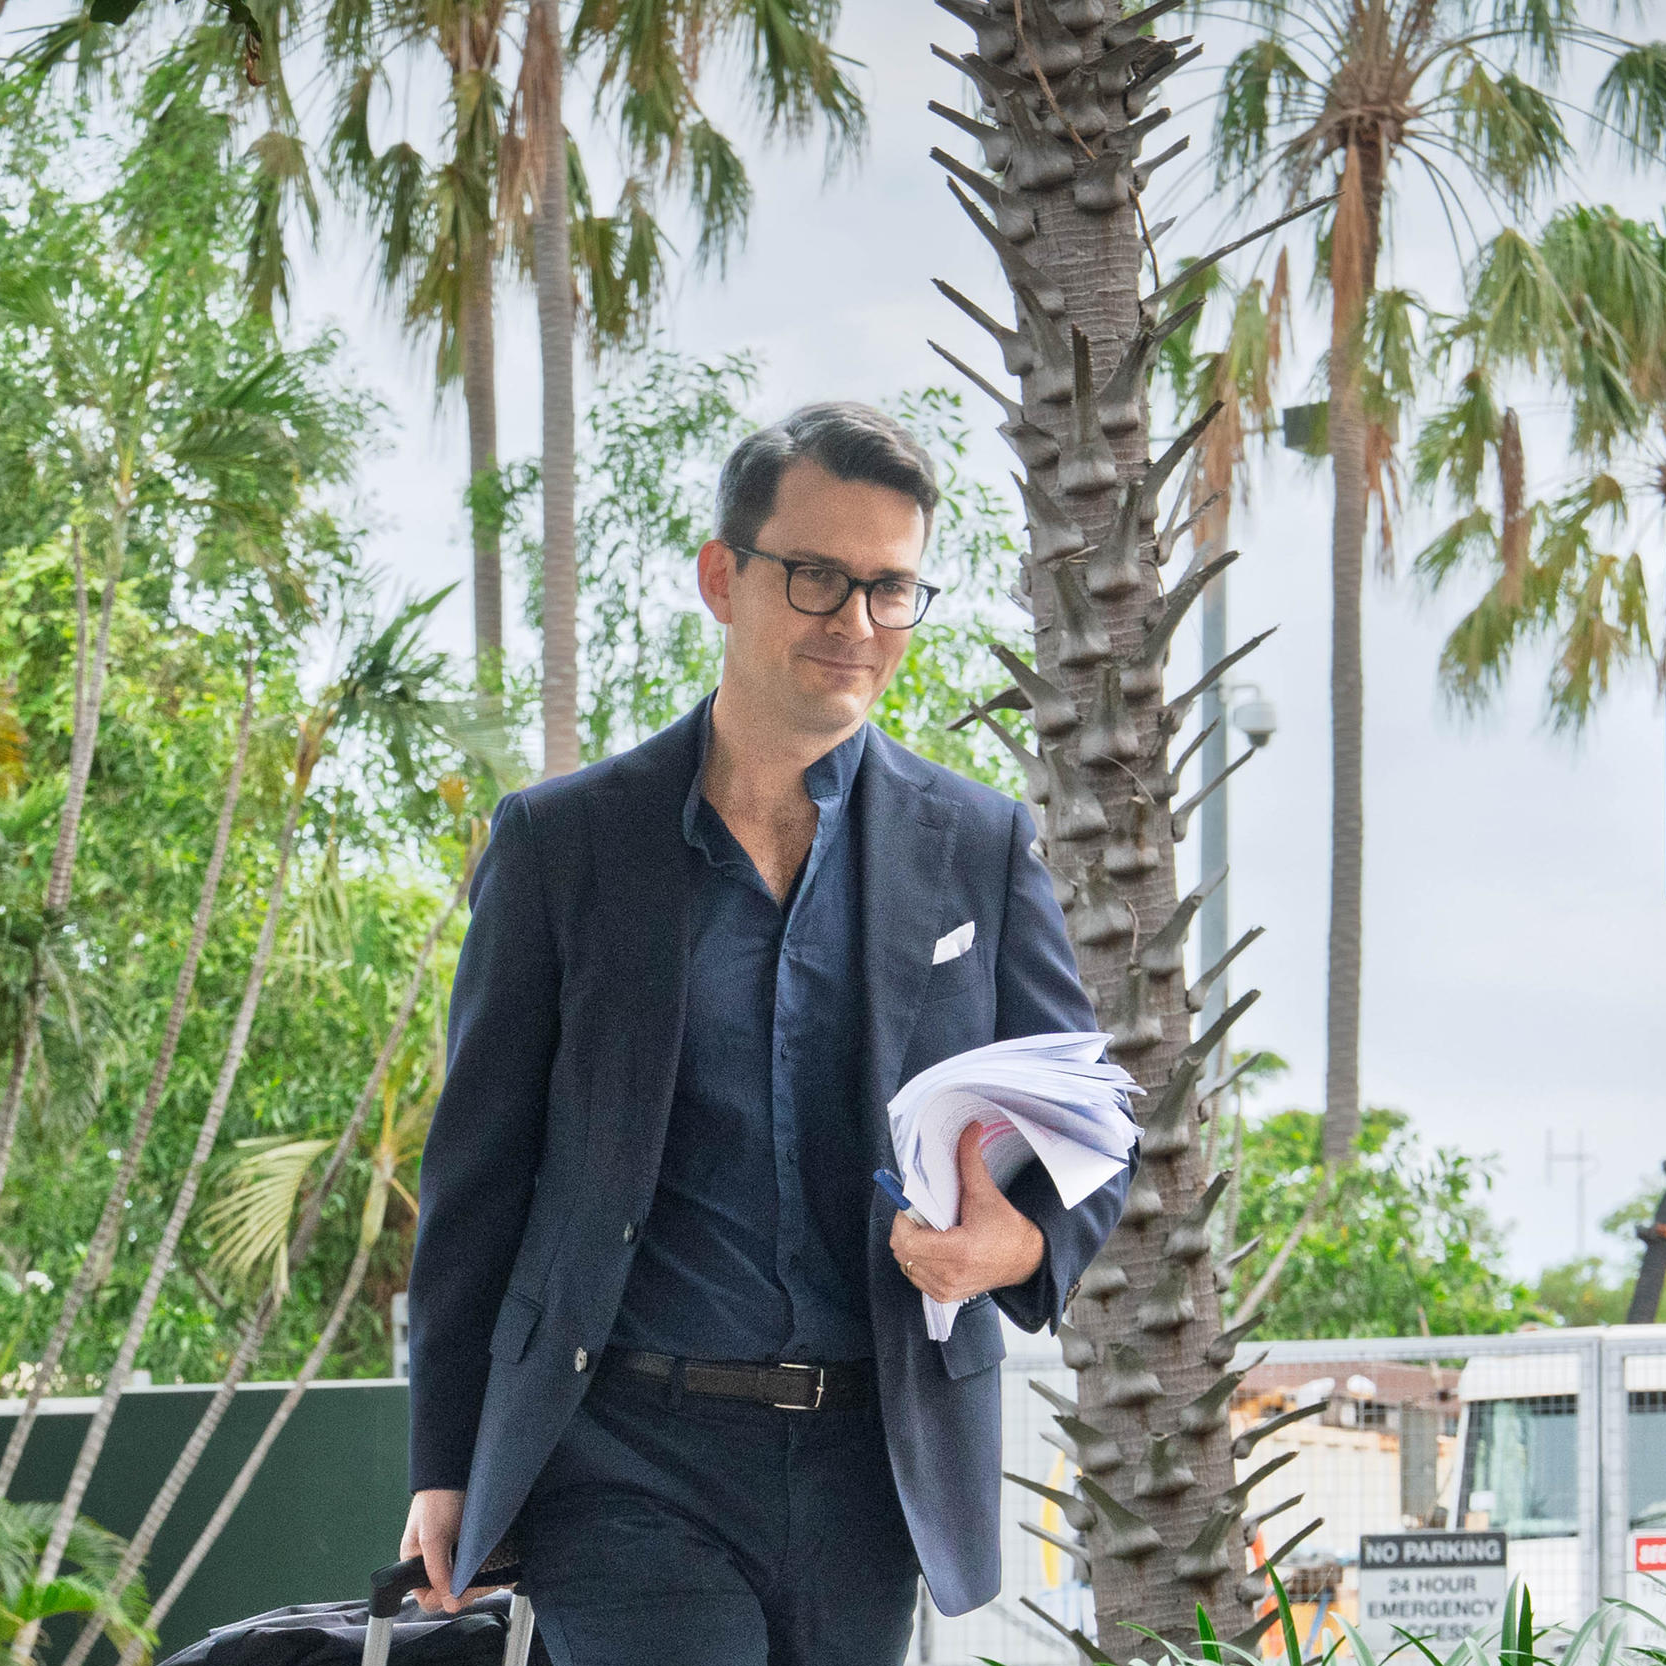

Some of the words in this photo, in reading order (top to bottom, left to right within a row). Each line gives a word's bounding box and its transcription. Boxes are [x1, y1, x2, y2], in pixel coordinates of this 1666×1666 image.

[1365, 1541, 1399, 1564] NO
[1402, 1538, 1502, 1563] PARKING
[1388, 1577, 1410, 1594] 24
[1416, 1574, 1477, 1594] HOUR
[1367, 1600, 1498, 1619] EMERGENCY
